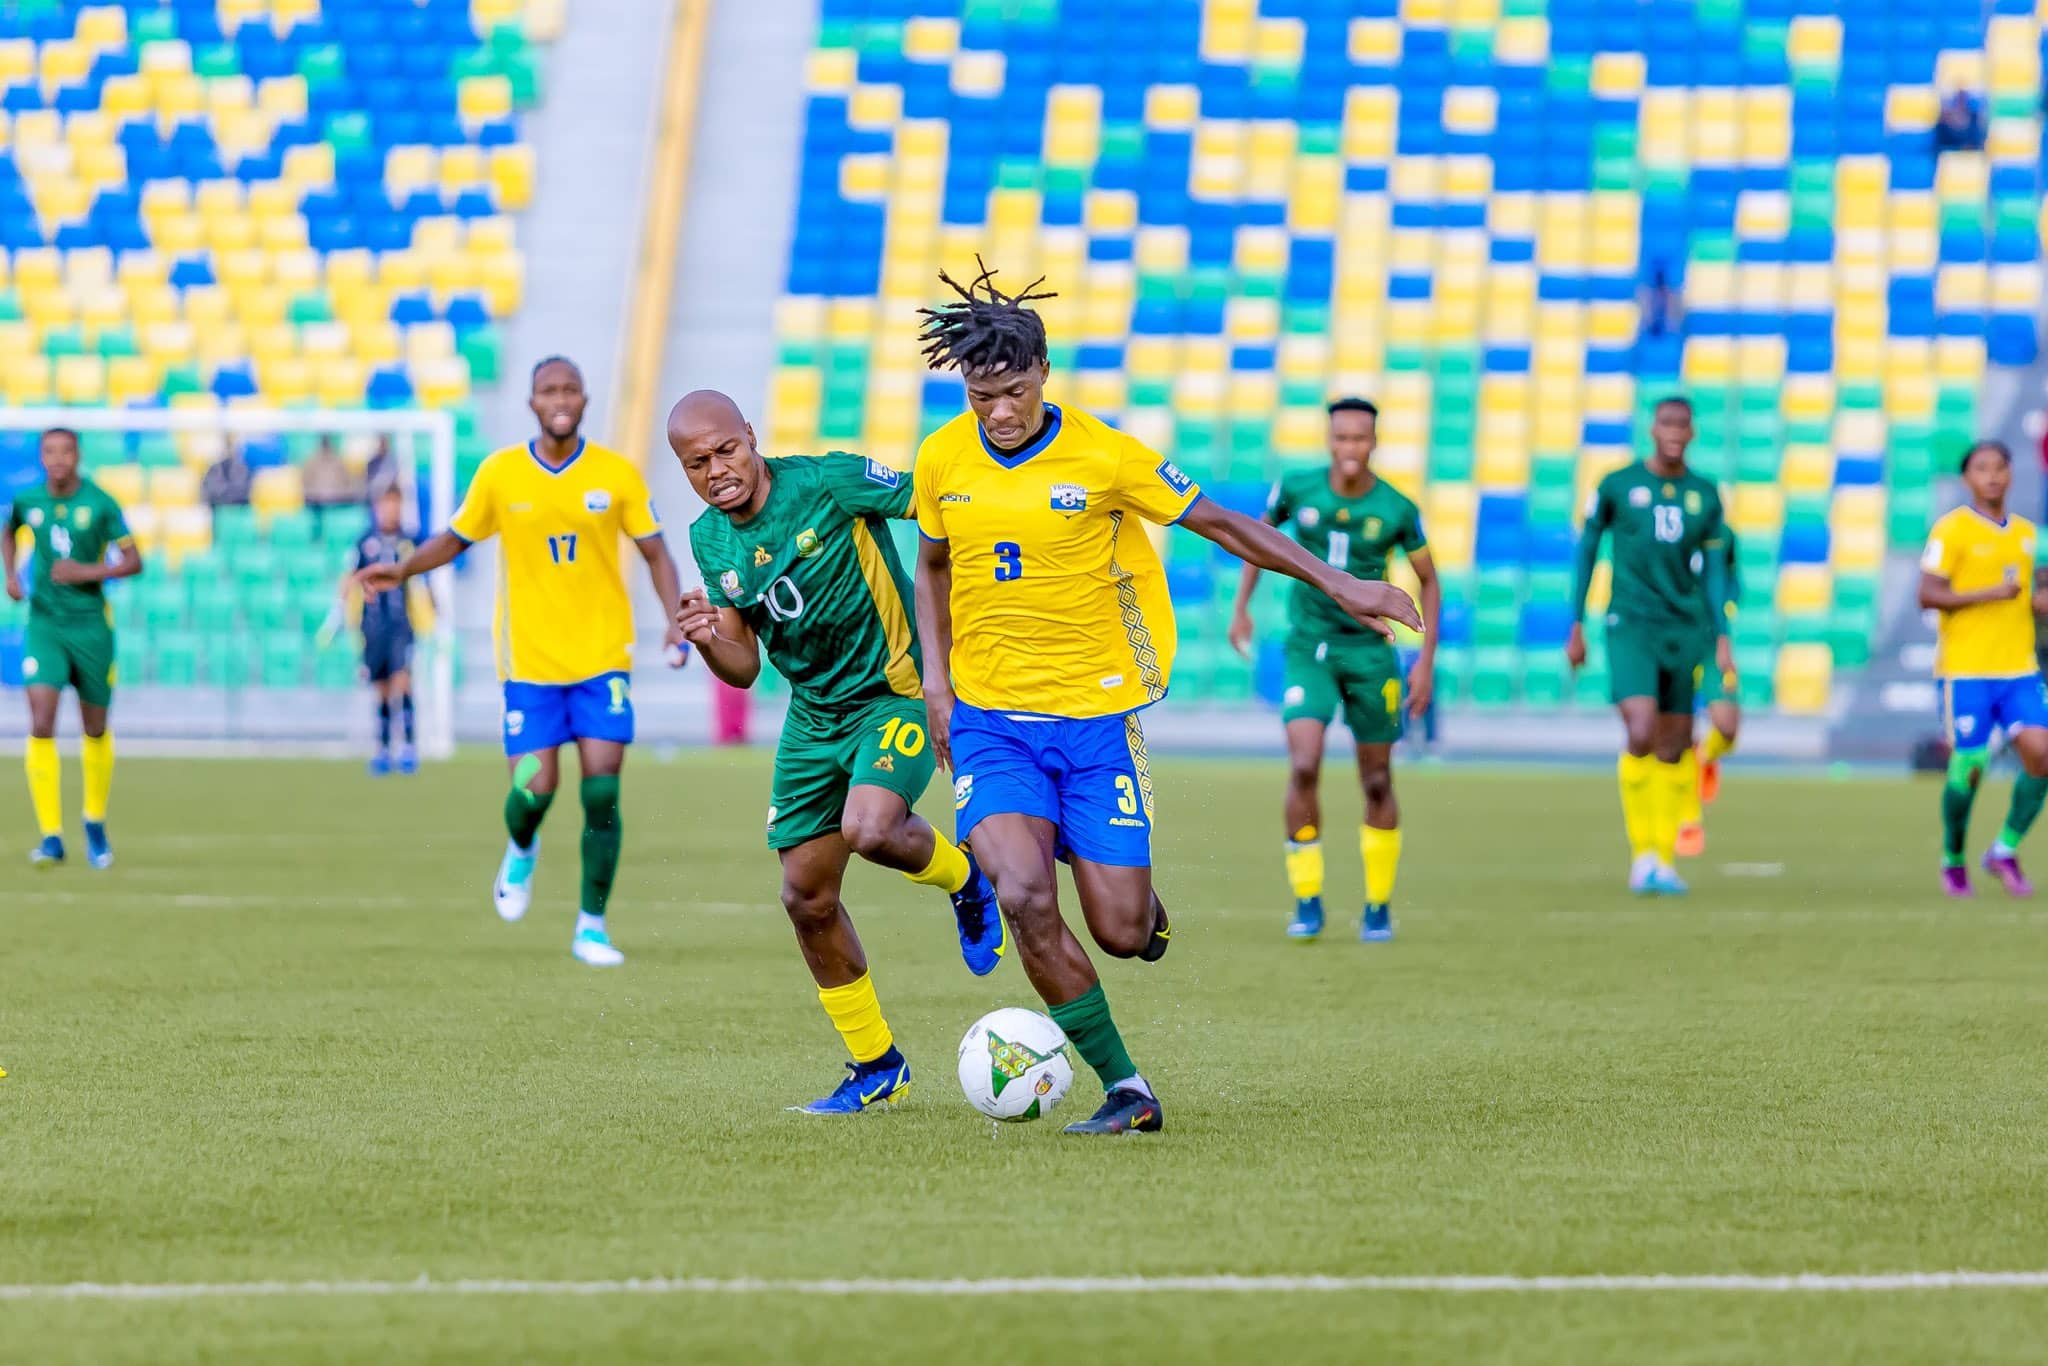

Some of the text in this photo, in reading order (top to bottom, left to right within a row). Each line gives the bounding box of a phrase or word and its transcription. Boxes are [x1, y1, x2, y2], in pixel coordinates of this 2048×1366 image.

[1654, 505, 1684, 543] 13
[548, 534, 577, 563] 17
[994, 541, 1022, 582] 3
[756, 575, 804, 621] 10
[877, 717, 926, 757] 10
[1115, 775, 1137, 815] 3
